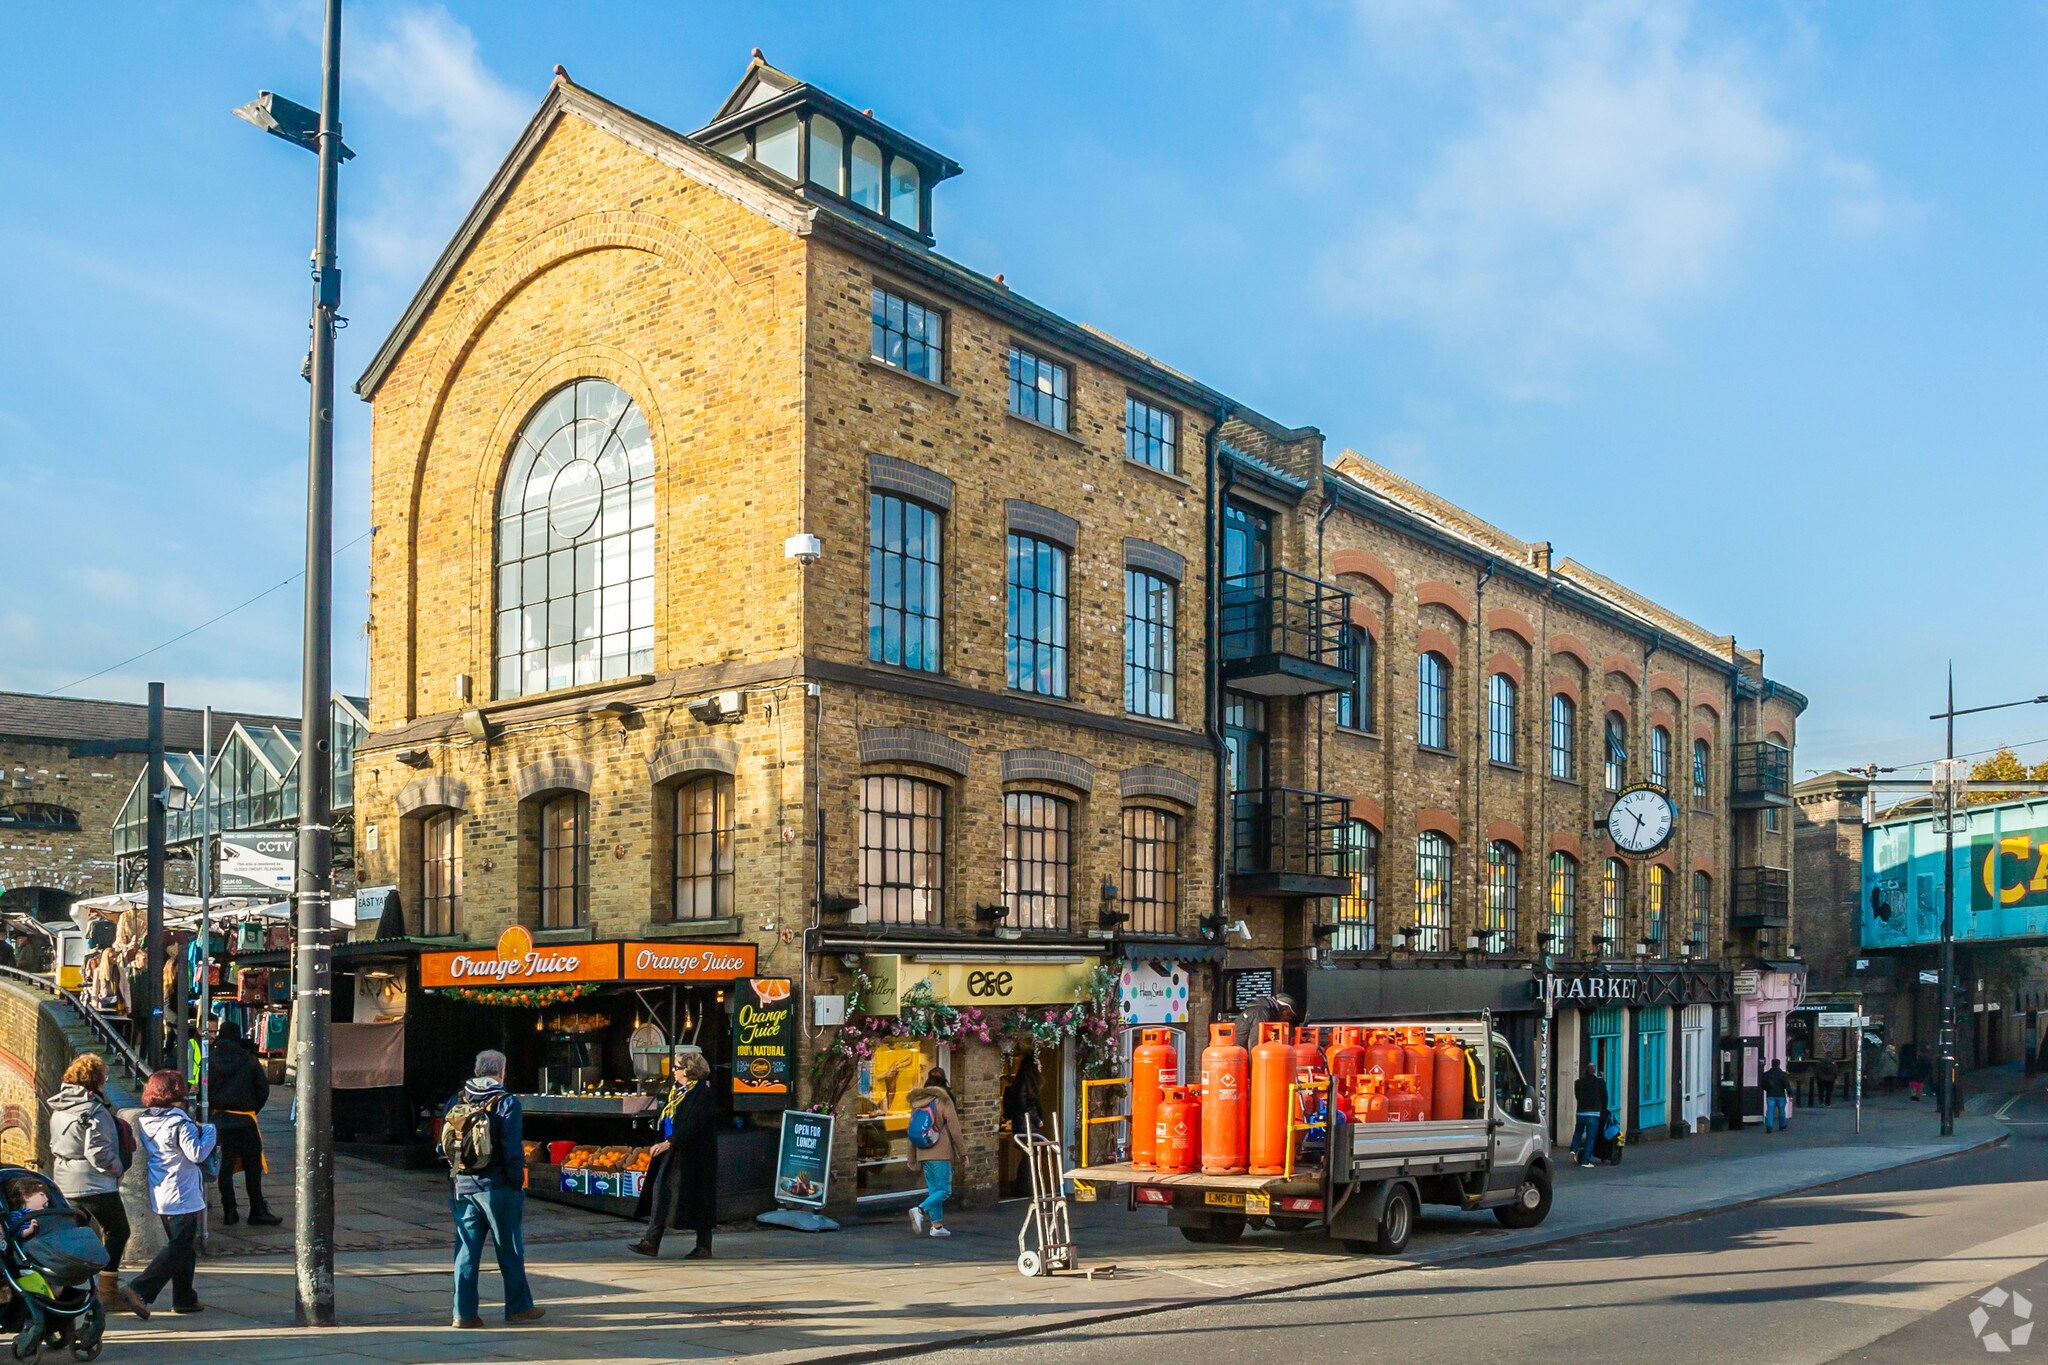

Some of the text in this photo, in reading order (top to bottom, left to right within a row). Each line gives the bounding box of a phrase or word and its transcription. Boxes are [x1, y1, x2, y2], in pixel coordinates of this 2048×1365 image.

[1618, 783, 1668, 797] CAMDEN LOCK
[256, 841, 293, 852] CCTV
[1619, 847, 1667, 860] MARKET HALL
[358, 897, 374, 908] EAST
[450, 952, 581, 981] Orange Juice
[636, 949, 745, 974] Orange Juice
[967, 970, 1013, 997] e&e
[1536, 977, 1638, 1000] MARKET
[1139, 982, 1152, 1000] Happy
[739, 1004, 788, 1027] Orange
[740, 1023, 781, 1044] Juice
[737, 1045, 786, 1057] 100% NATURAL
[794, 1123, 821, 1138] OPEN FOR
[796, 1136, 817, 1149] LUNCH!
[1209, 1193, 1233, 1204] LN64
[1247, 1200, 1269, 1209] DEL
